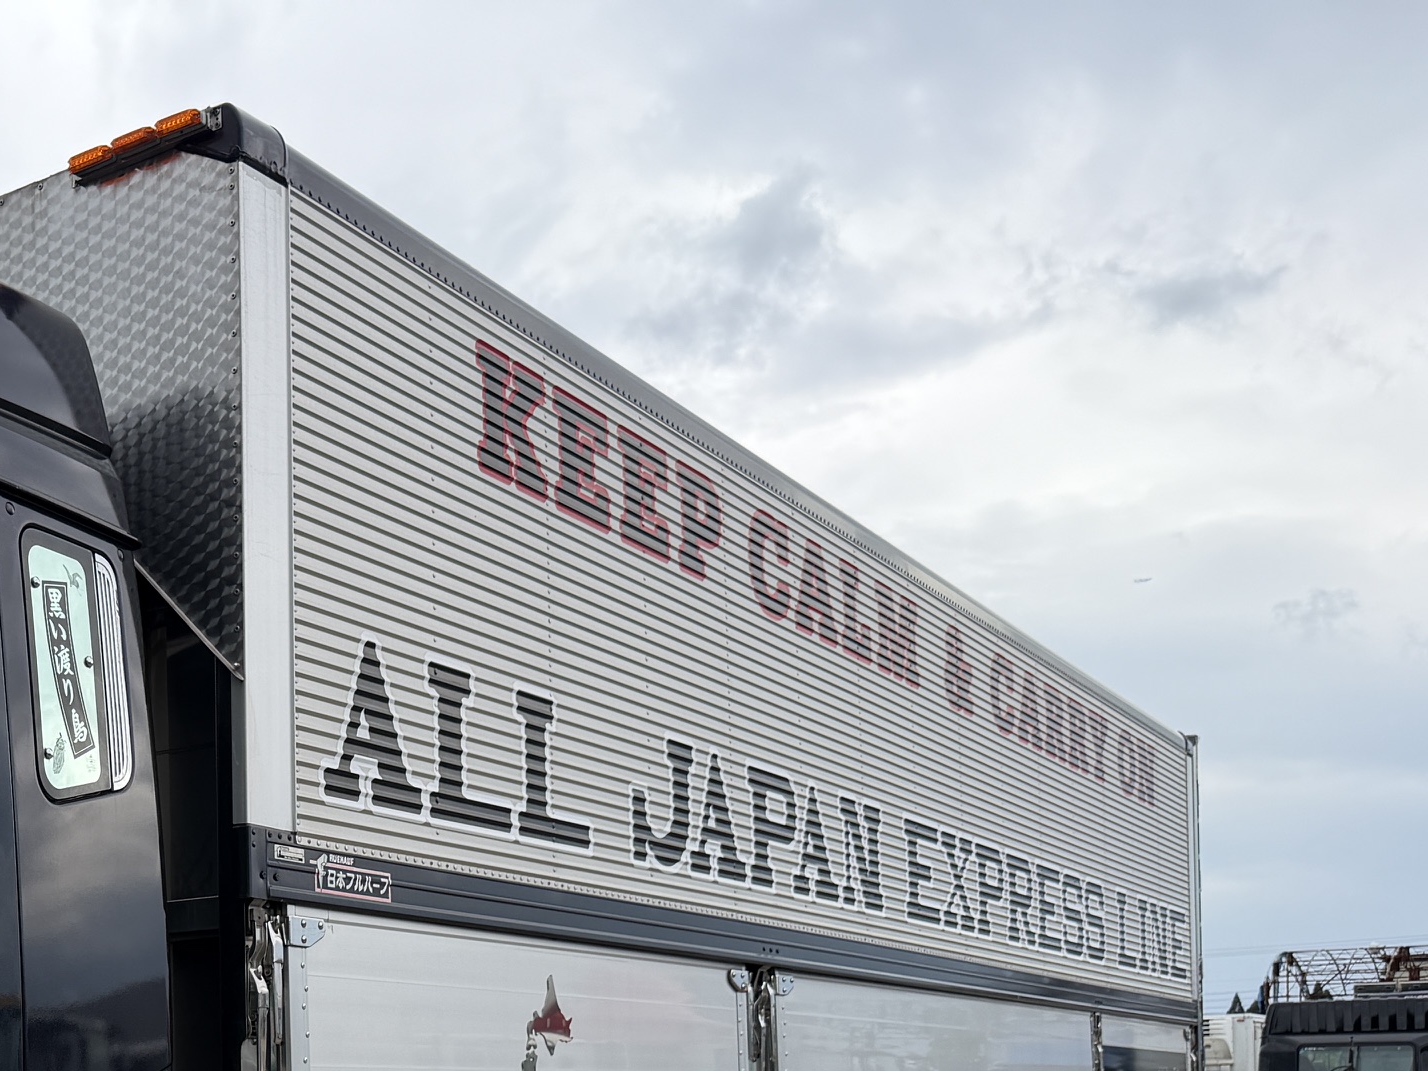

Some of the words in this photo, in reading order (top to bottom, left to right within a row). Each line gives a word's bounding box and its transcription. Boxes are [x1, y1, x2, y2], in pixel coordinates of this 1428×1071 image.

[47, 587, 88, 744] 黒い渡り鳥
[475, 339, 723, 579] KEEP
[747, 509, 920, 690] CALM
[943, 624, 974, 717] &
[990, 652, 1108, 783] CARRY
[1117, 729, 1155, 807] ON
[319, 631, 594, 856] ALL
[629, 731, 886, 917] JAPAN
[902, 812, 1107, 965] EXPRESS
[1115, 886, 1190, 982] LINE
[327, 869, 391, 895] 日本フルハーフ
